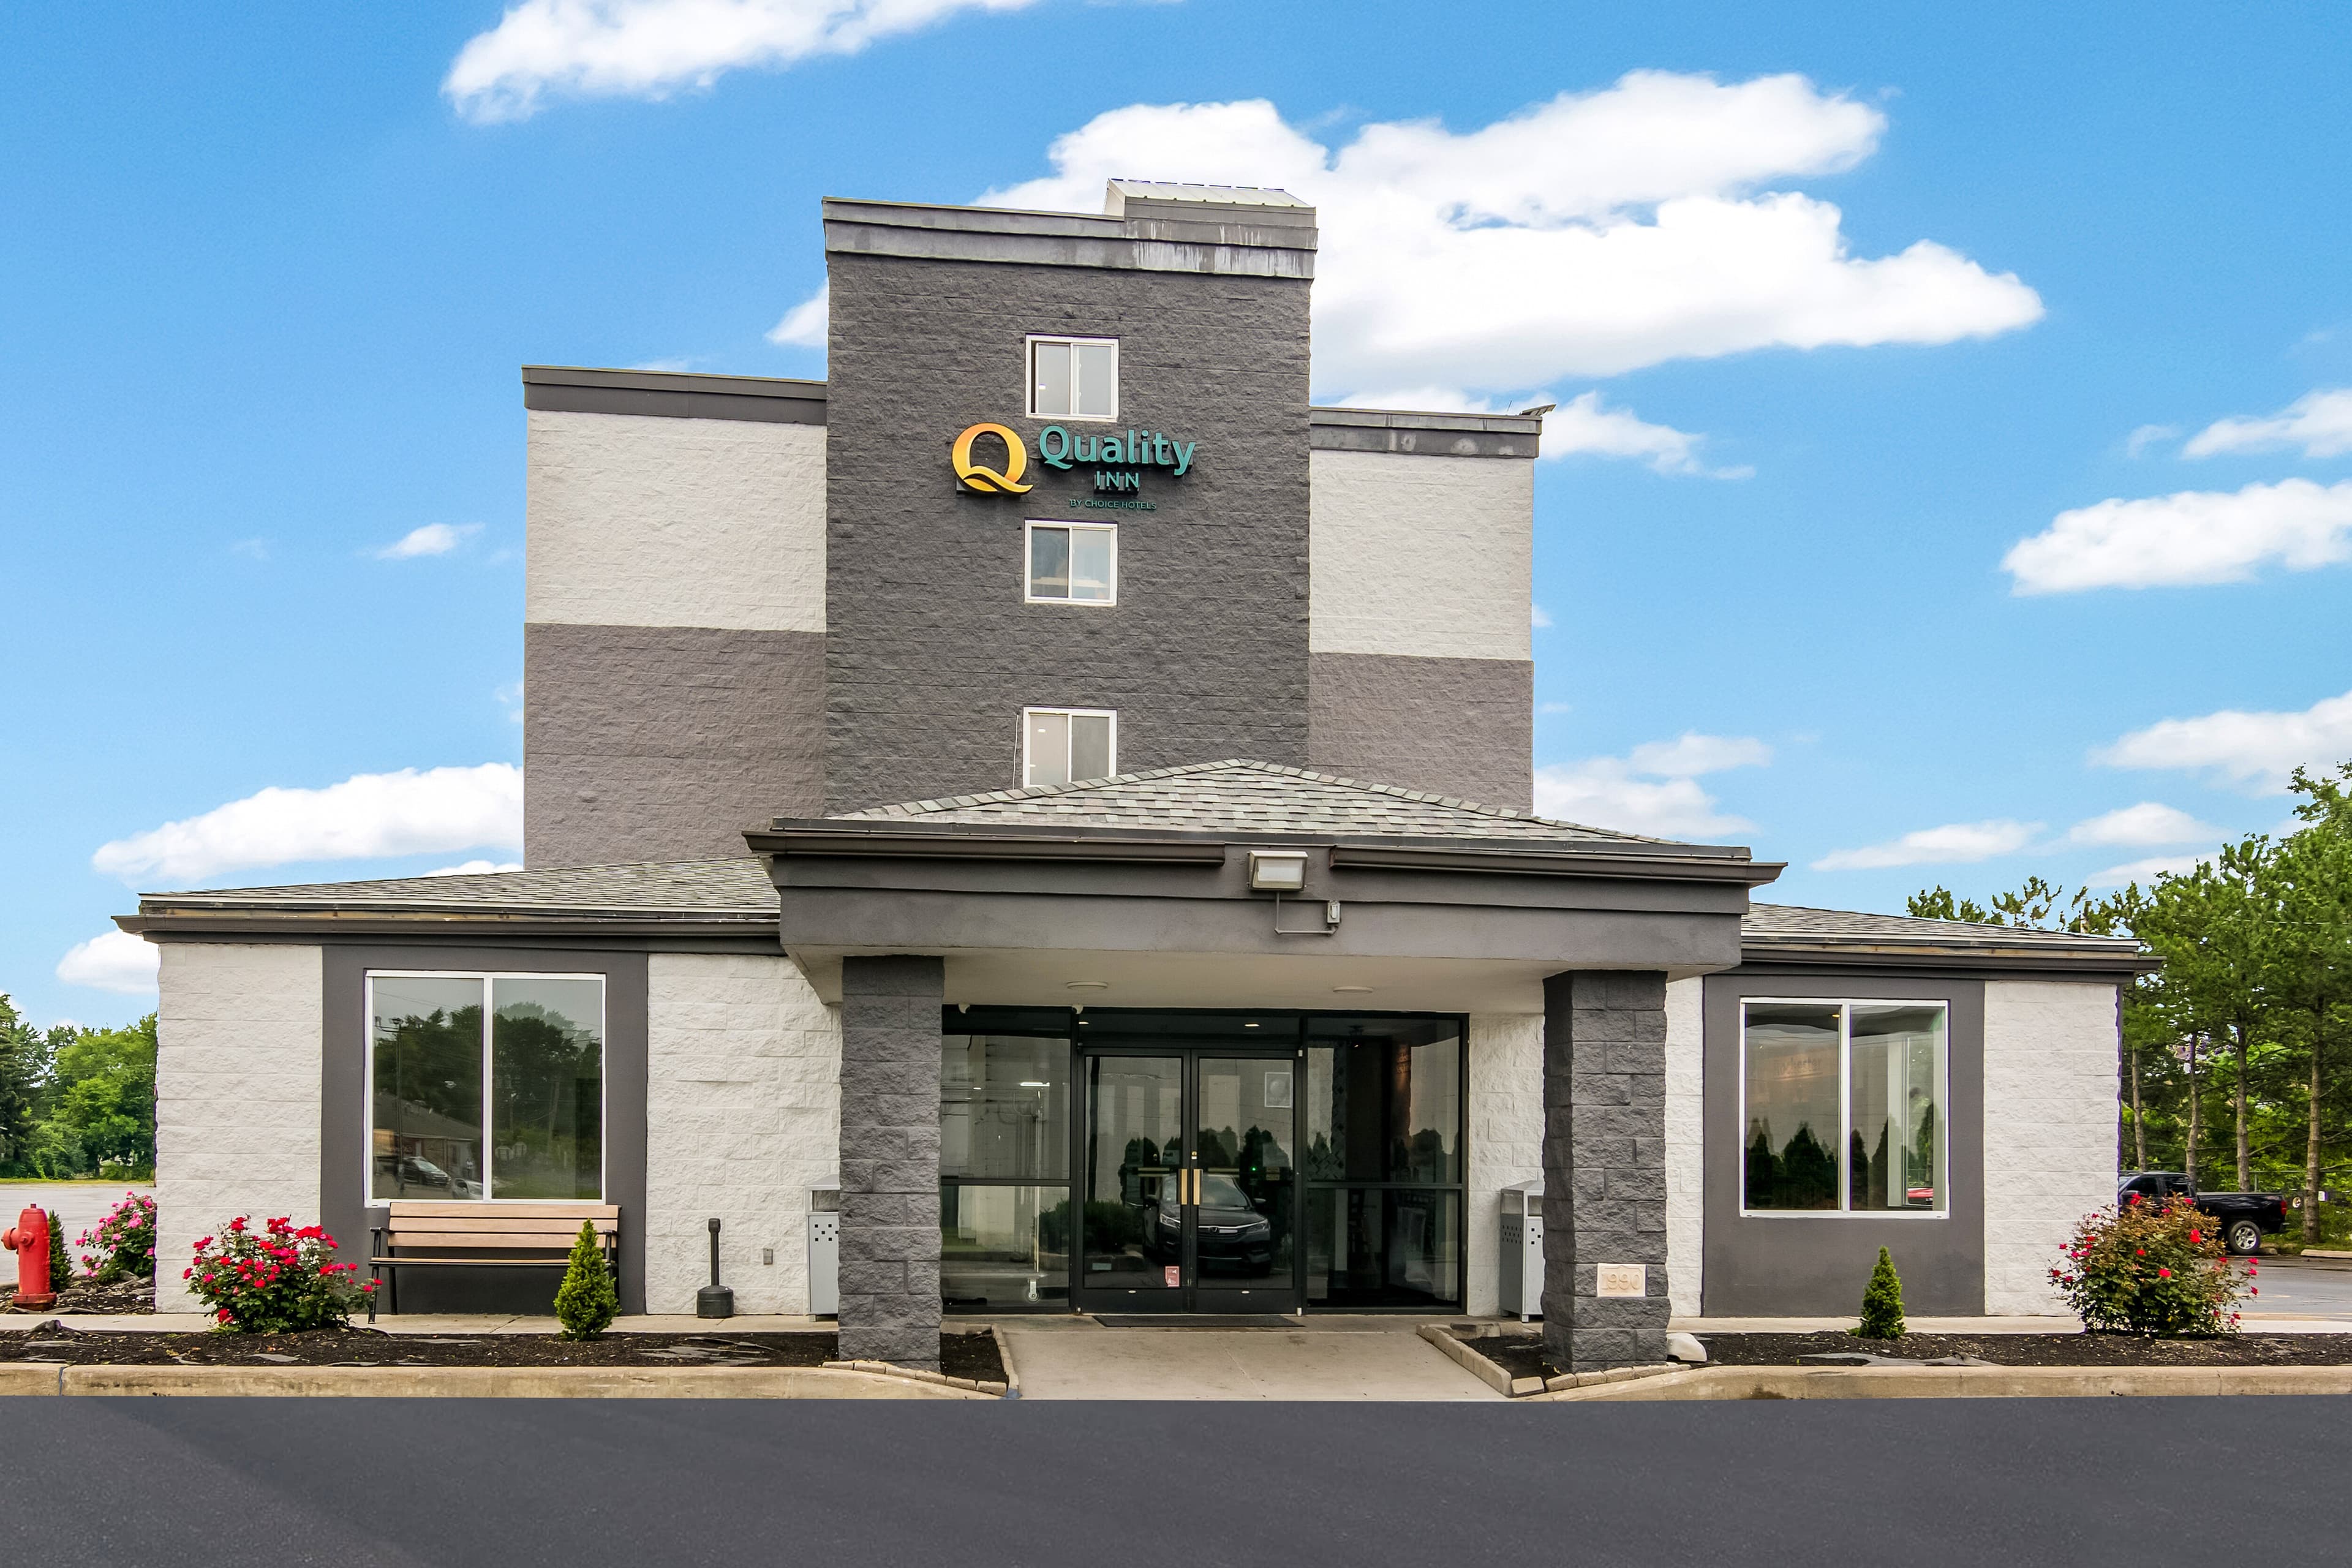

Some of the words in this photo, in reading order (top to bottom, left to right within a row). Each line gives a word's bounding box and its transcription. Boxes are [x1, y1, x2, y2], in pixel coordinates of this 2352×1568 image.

[951, 422, 1034, 495] Q
[1039, 425, 1196, 476] Quality
[1095, 470, 1140, 489] INN
[1085, 499, 1119, 509] CHOICE
[1121, 501, 1157, 510] HOTELS
[1602, 1273, 1641, 1291] 1990
